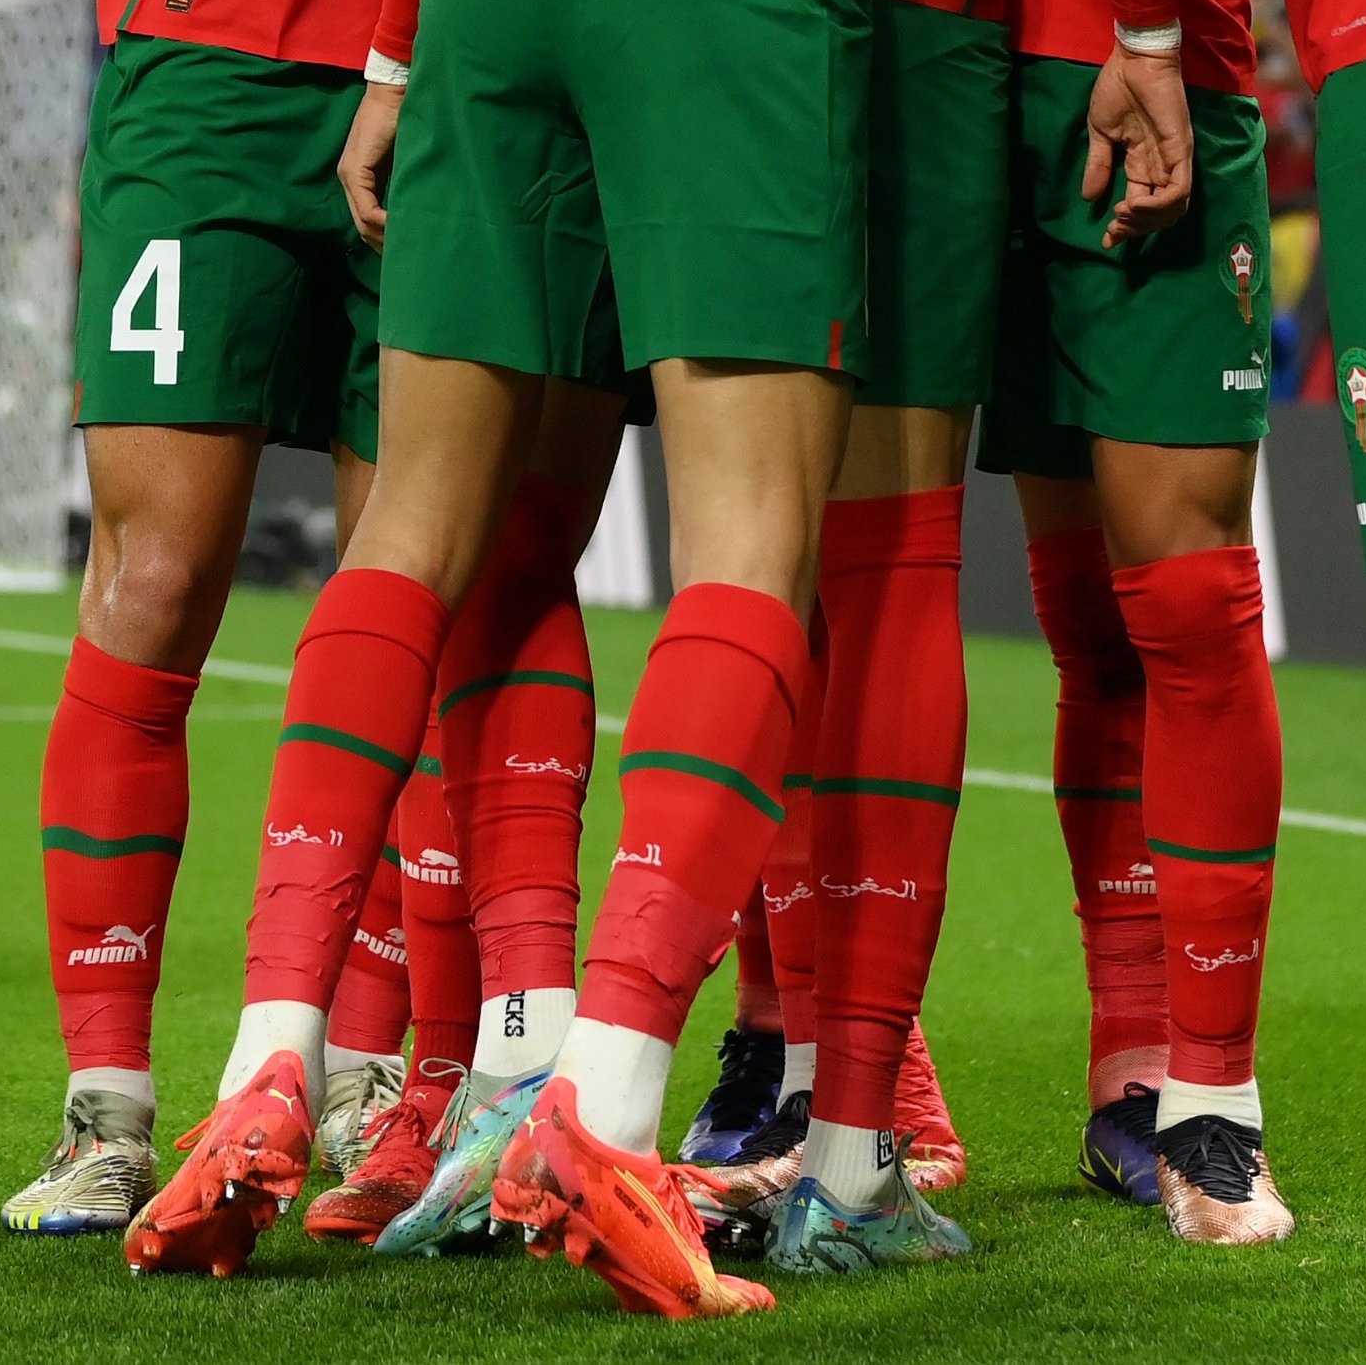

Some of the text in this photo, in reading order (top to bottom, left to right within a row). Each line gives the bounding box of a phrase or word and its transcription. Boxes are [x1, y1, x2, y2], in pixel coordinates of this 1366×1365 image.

[110, 239, 185, 386] 4
[1223, 369, 1263, 391] PUMA
[820, 874, 917, 902] المغرب
[1098, 880, 1157, 895] PUM
[67, 945, 138, 966] PUMA
[353, 928, 409, 967] PUM
[1184, 938, 1260, 973] المغرب
